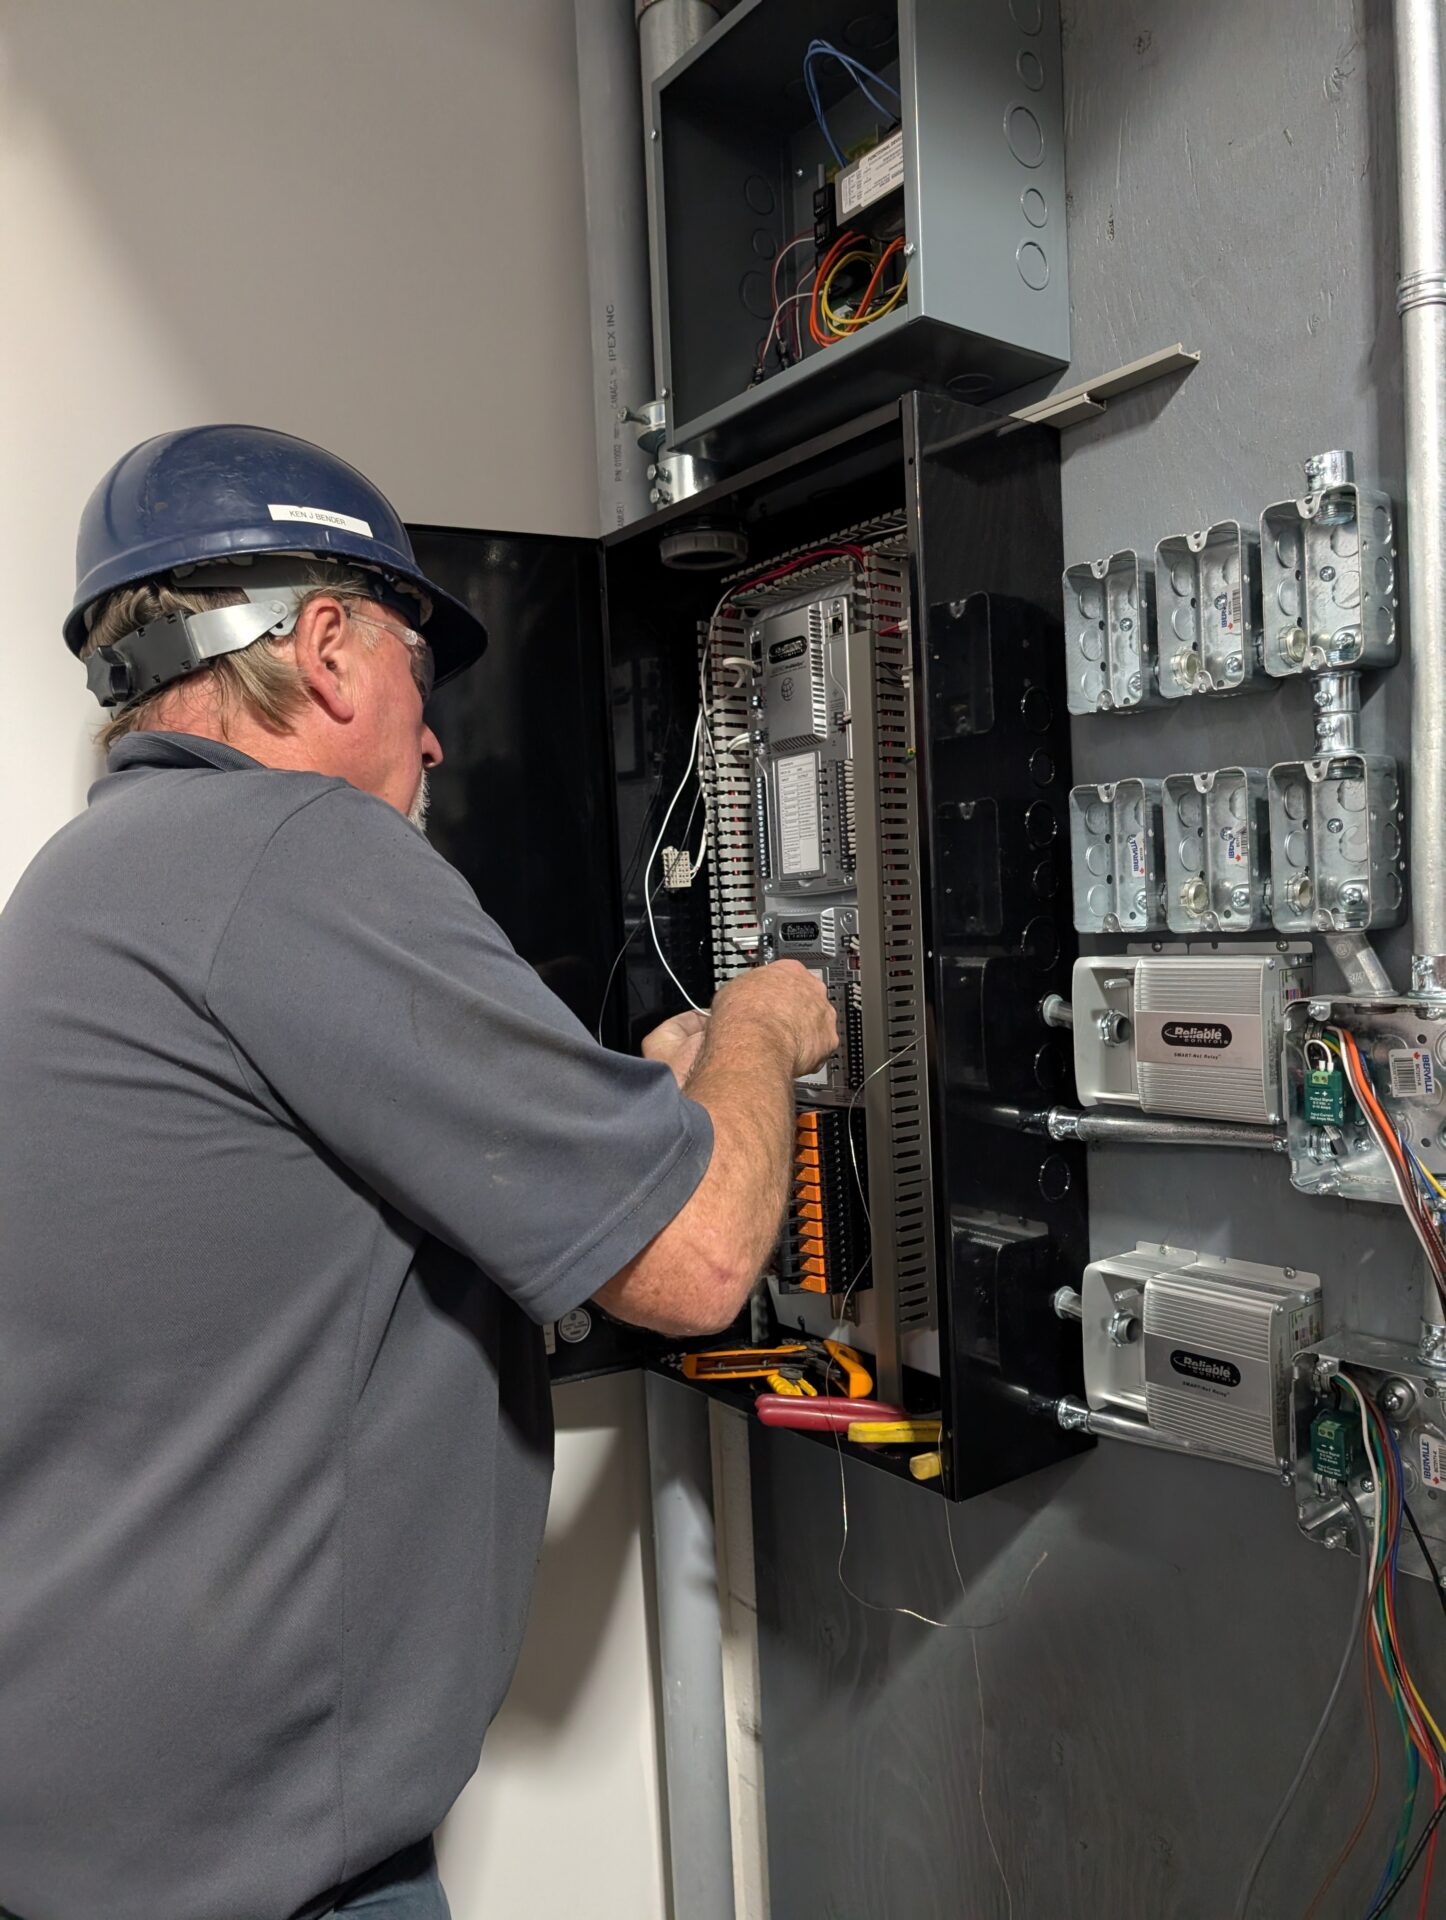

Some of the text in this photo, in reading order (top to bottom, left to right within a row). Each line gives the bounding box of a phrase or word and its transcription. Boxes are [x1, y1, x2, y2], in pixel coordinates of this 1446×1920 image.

[606, 304, 615, 327] INC
[608, 331, 616, 361] IPEX
[289, 510, 307, 518] KEN
[315, 513, 346, 526] BENDER
[1174, 1027, 1222, 1040] Reliable
[1422, 1054, 1432, 1093] IBERVILLE
[1183, 1356, 1231, 1378] Reliable
[1422, 1440, 1431, 1479] IBERVILLE
